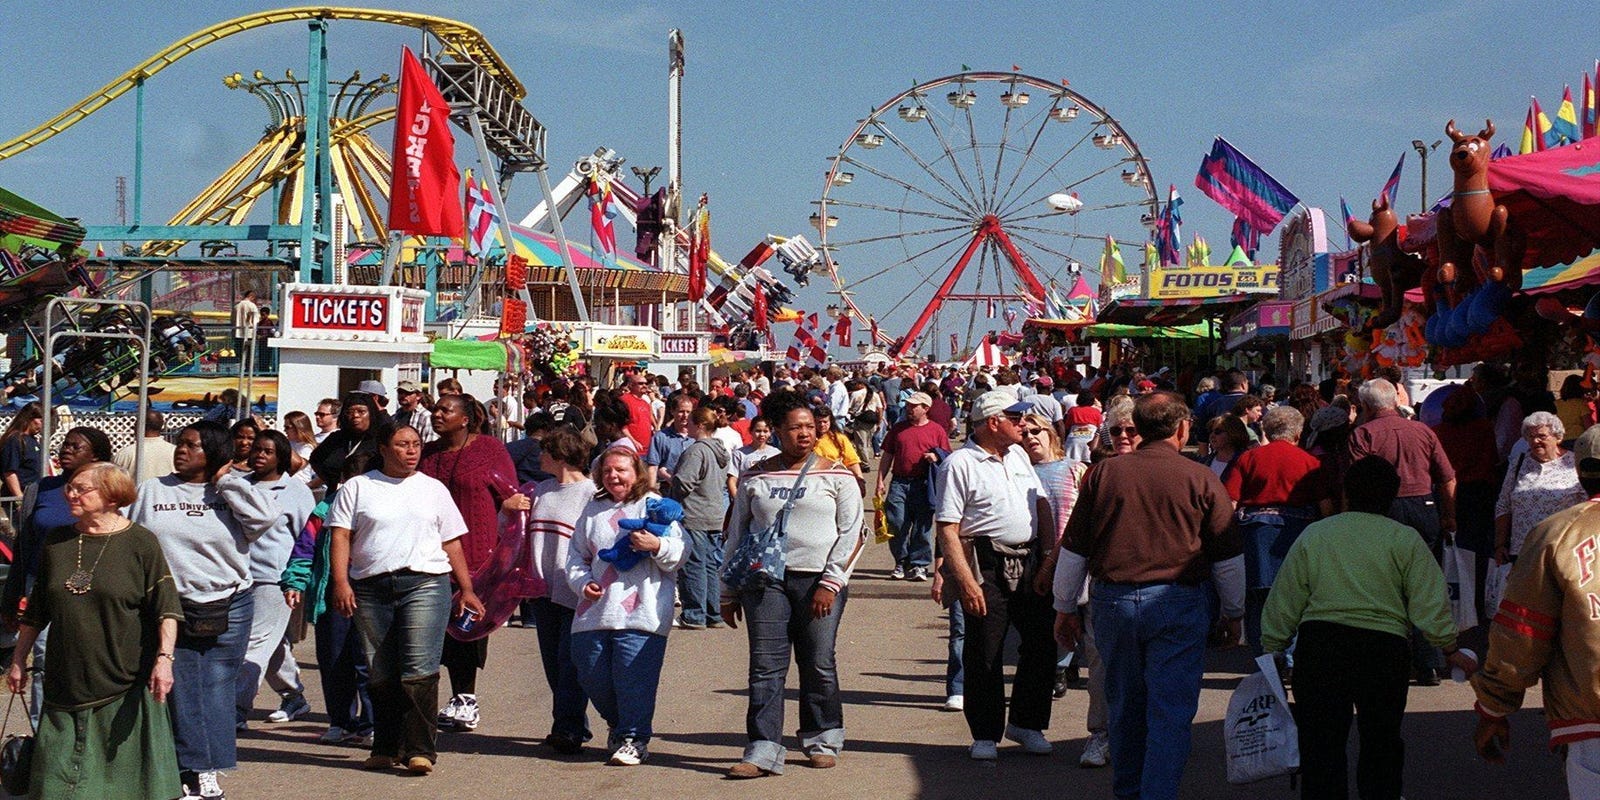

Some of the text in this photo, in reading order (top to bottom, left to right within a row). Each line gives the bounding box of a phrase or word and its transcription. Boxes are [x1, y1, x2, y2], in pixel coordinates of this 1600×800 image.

[1163, 273, 1280, 287] FOTOS F
[302, 298, 382, 325] TICKETS
[662, 339, 695, 352] ICKETS
[769, 486, 807, 500] FUU
[153, 503, 177, 511] YALE
[1243, 695, 1276, 713] ARP
